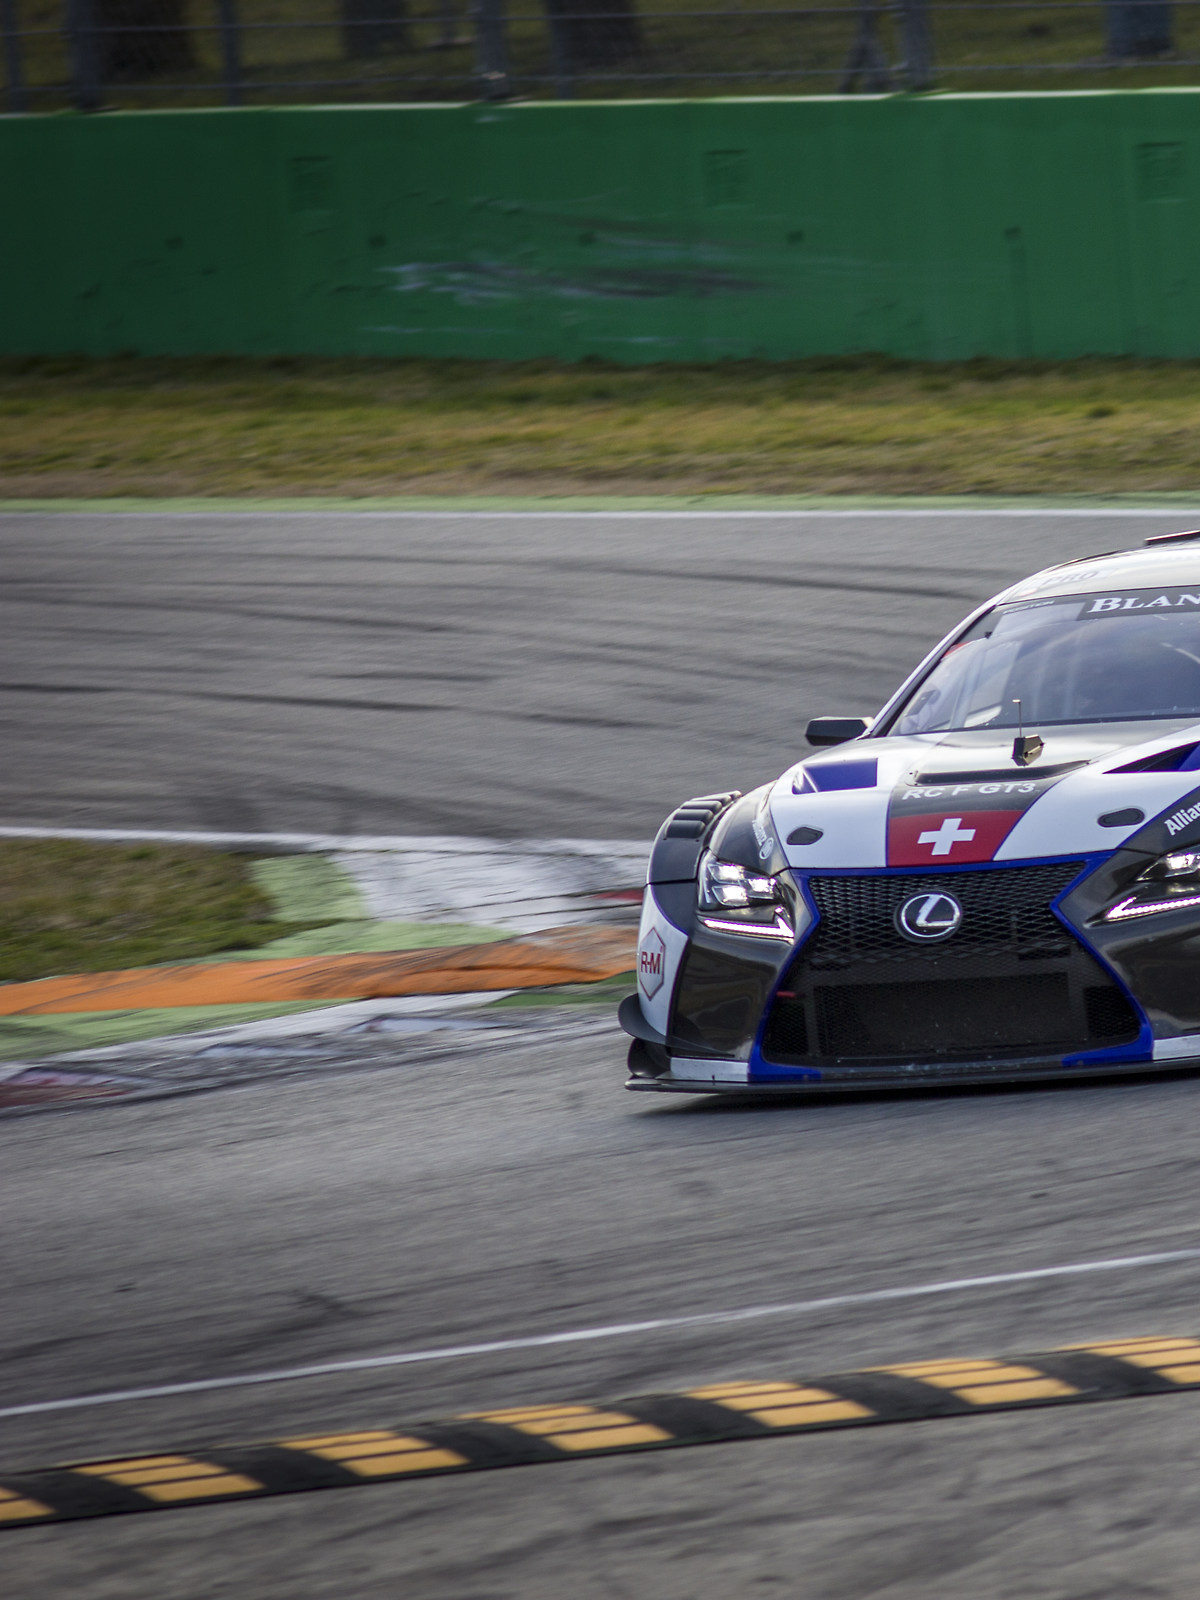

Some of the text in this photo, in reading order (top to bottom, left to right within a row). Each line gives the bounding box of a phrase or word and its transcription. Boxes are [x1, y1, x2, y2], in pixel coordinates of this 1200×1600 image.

[902, 782, 1036, 800] RC F GT3
[640, 951, 662, 975] R-M
